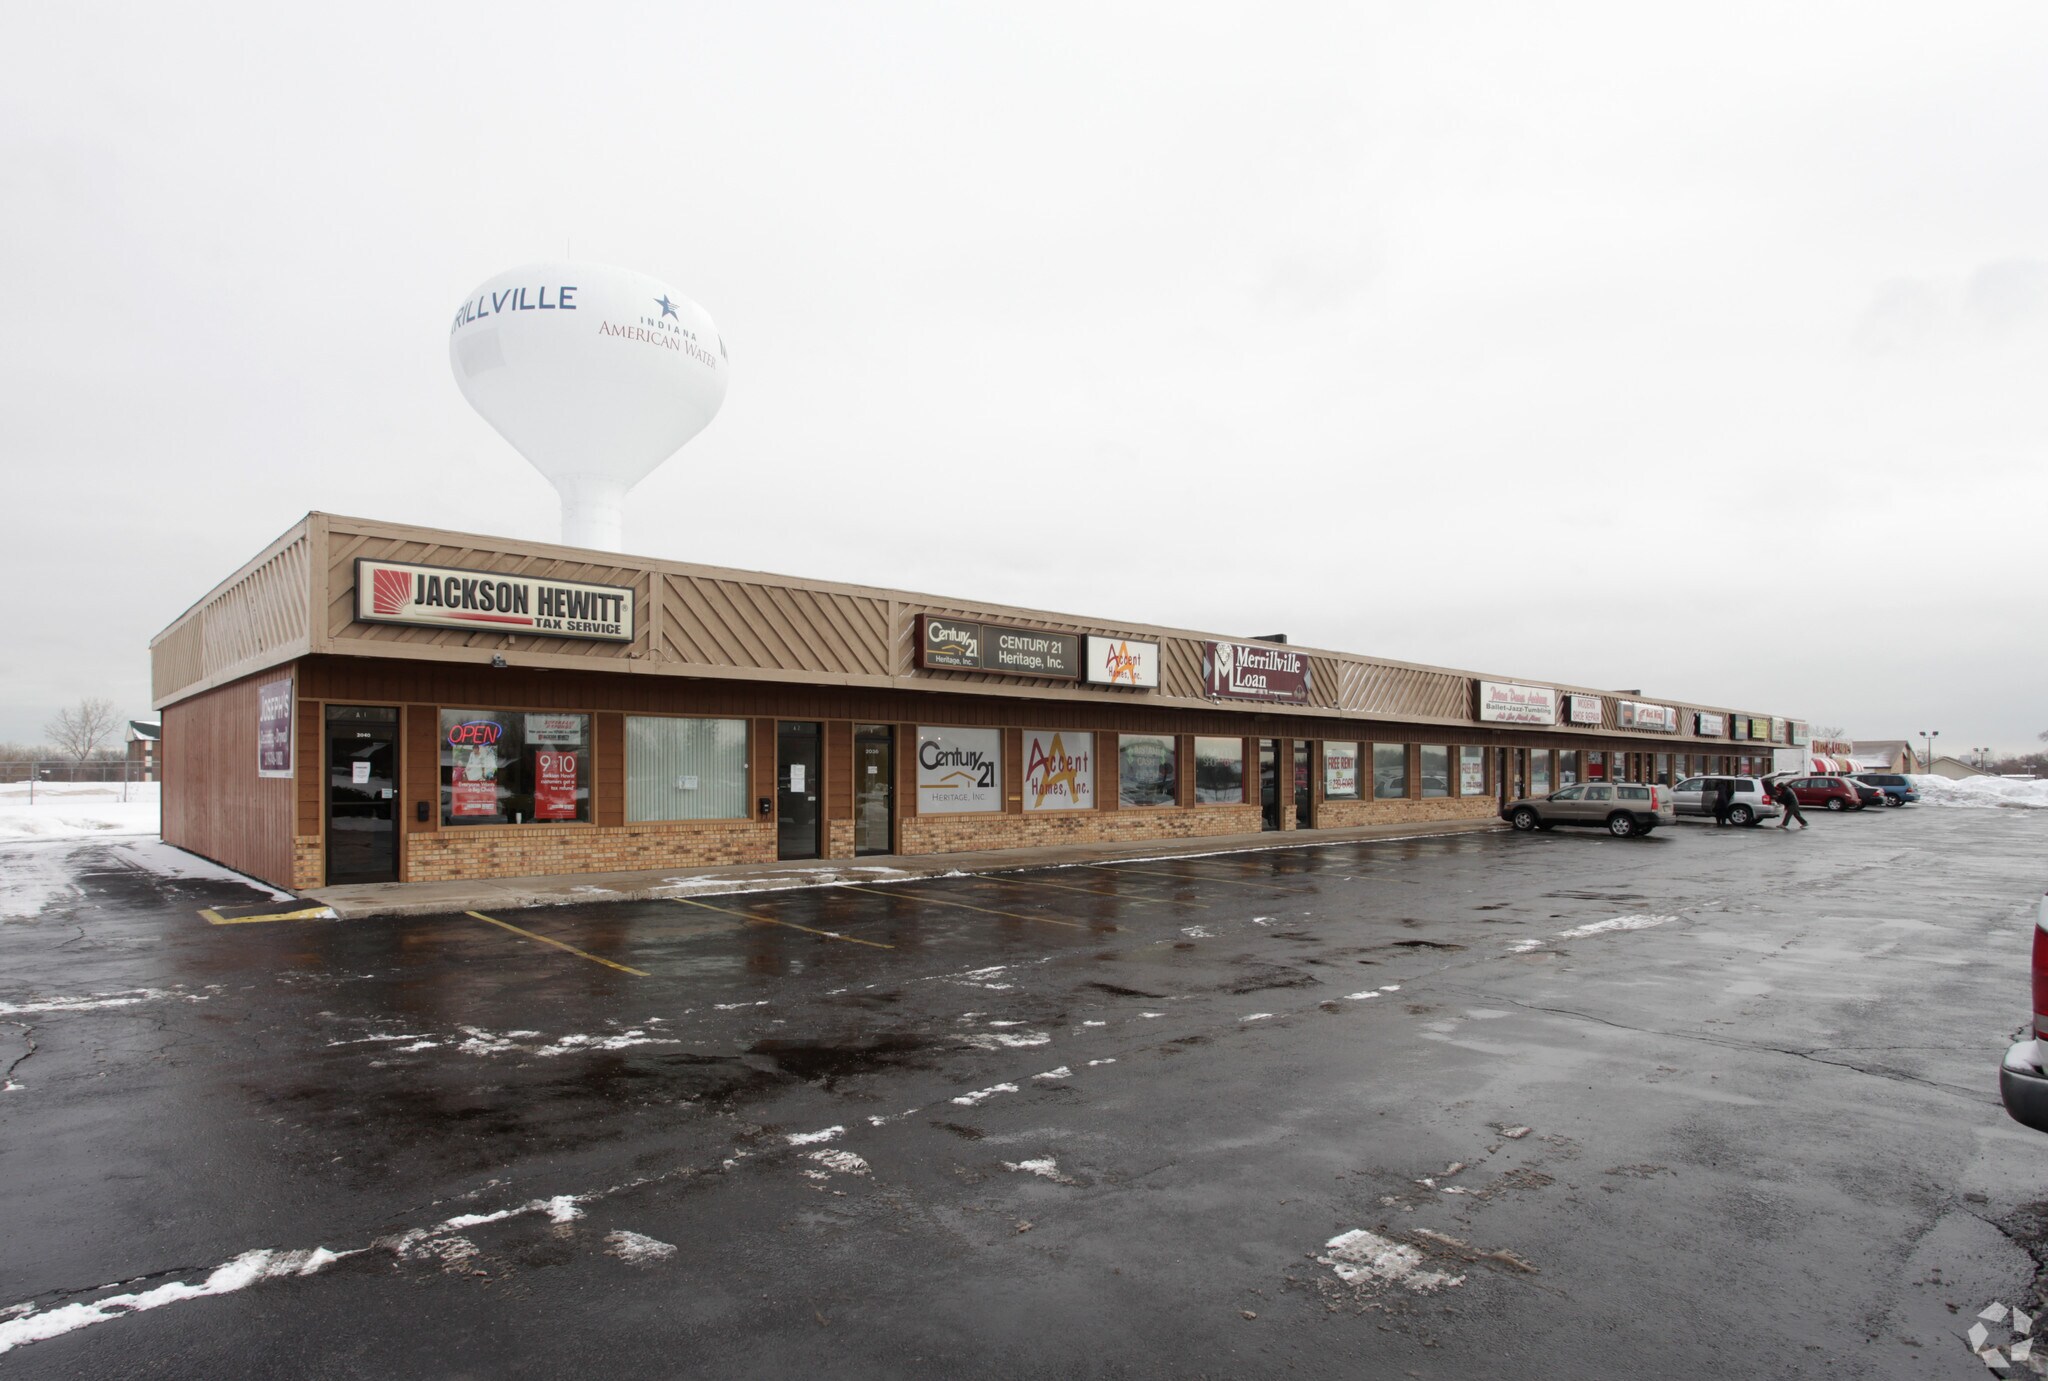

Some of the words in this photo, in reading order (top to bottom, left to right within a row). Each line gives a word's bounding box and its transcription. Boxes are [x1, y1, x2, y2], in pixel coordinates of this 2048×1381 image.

[451, 286, 578, 334] RILLVILLE
[640, 316, 697, 341] INDIANA
[599, 320, 680, 351] AMERICAN
[685, 340, 717, 370] WATER
[414, 574, 529, 614] JACKSON
[538, 586, 624, 622] HEWITT
[534, 617, 562, 630] TAX
[567, 620, 622, 635] SERVICE
[928, 622, 970, 643] Century
[965, 638, 978, 657] 21
[999, 635, 1049, 651] CENTURY
[1051, 641, 1062, 654] 21
[935, 655, 961, 666] Heritage,
[962, 657, 973, 666] Inc.
[998, 651, 1045, 669] Heritage,
[1047, 656, 1064, 669] Inc.
[1235, 646, 1301, 673] Merrillville
[1235, 666, 1267, 688] Loan
[450, 725, 498, 744] OPEN
[540, 755, 551, 772] 9
[558, 755, 575, 773] 10
[919, 740, 984, 770] Century
[976, 761, 995, 788] 21
[1025, 738, 1088, 783] Accent
[1328, 756, 1340, 769] FREE
[1341, 756, 1354, 769] RENT
[1031, 778, 1067, 797] Homes,
[1072, 777, 1090, 795] Inc.
